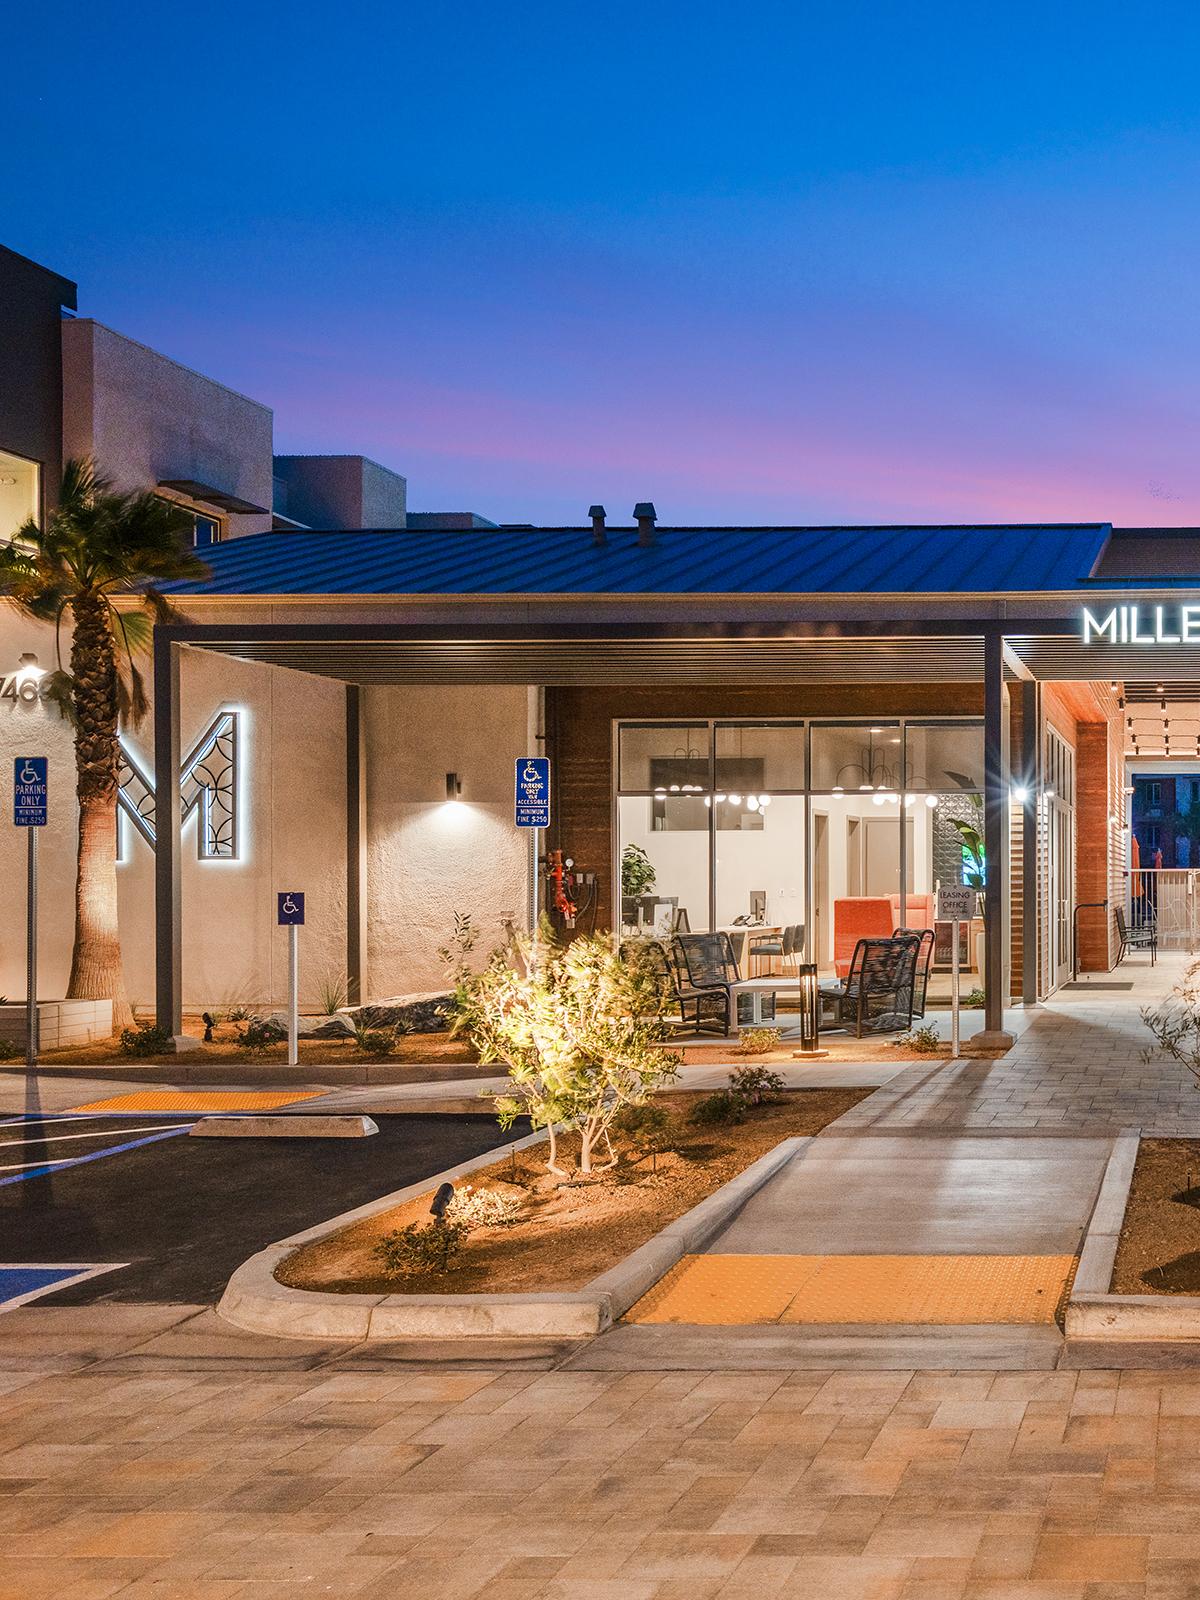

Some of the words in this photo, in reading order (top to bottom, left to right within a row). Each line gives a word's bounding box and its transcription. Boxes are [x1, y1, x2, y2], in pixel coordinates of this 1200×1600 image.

[15, 785, 46, 794] PARKING
[21, 796, 40, 805] ONLY
[16, 816, 28, 824] FINE
[30, 816, 45, 824] $250
[940, 891, 970, 899] LEASING
[943, 901, 967, 909] OFFICE
